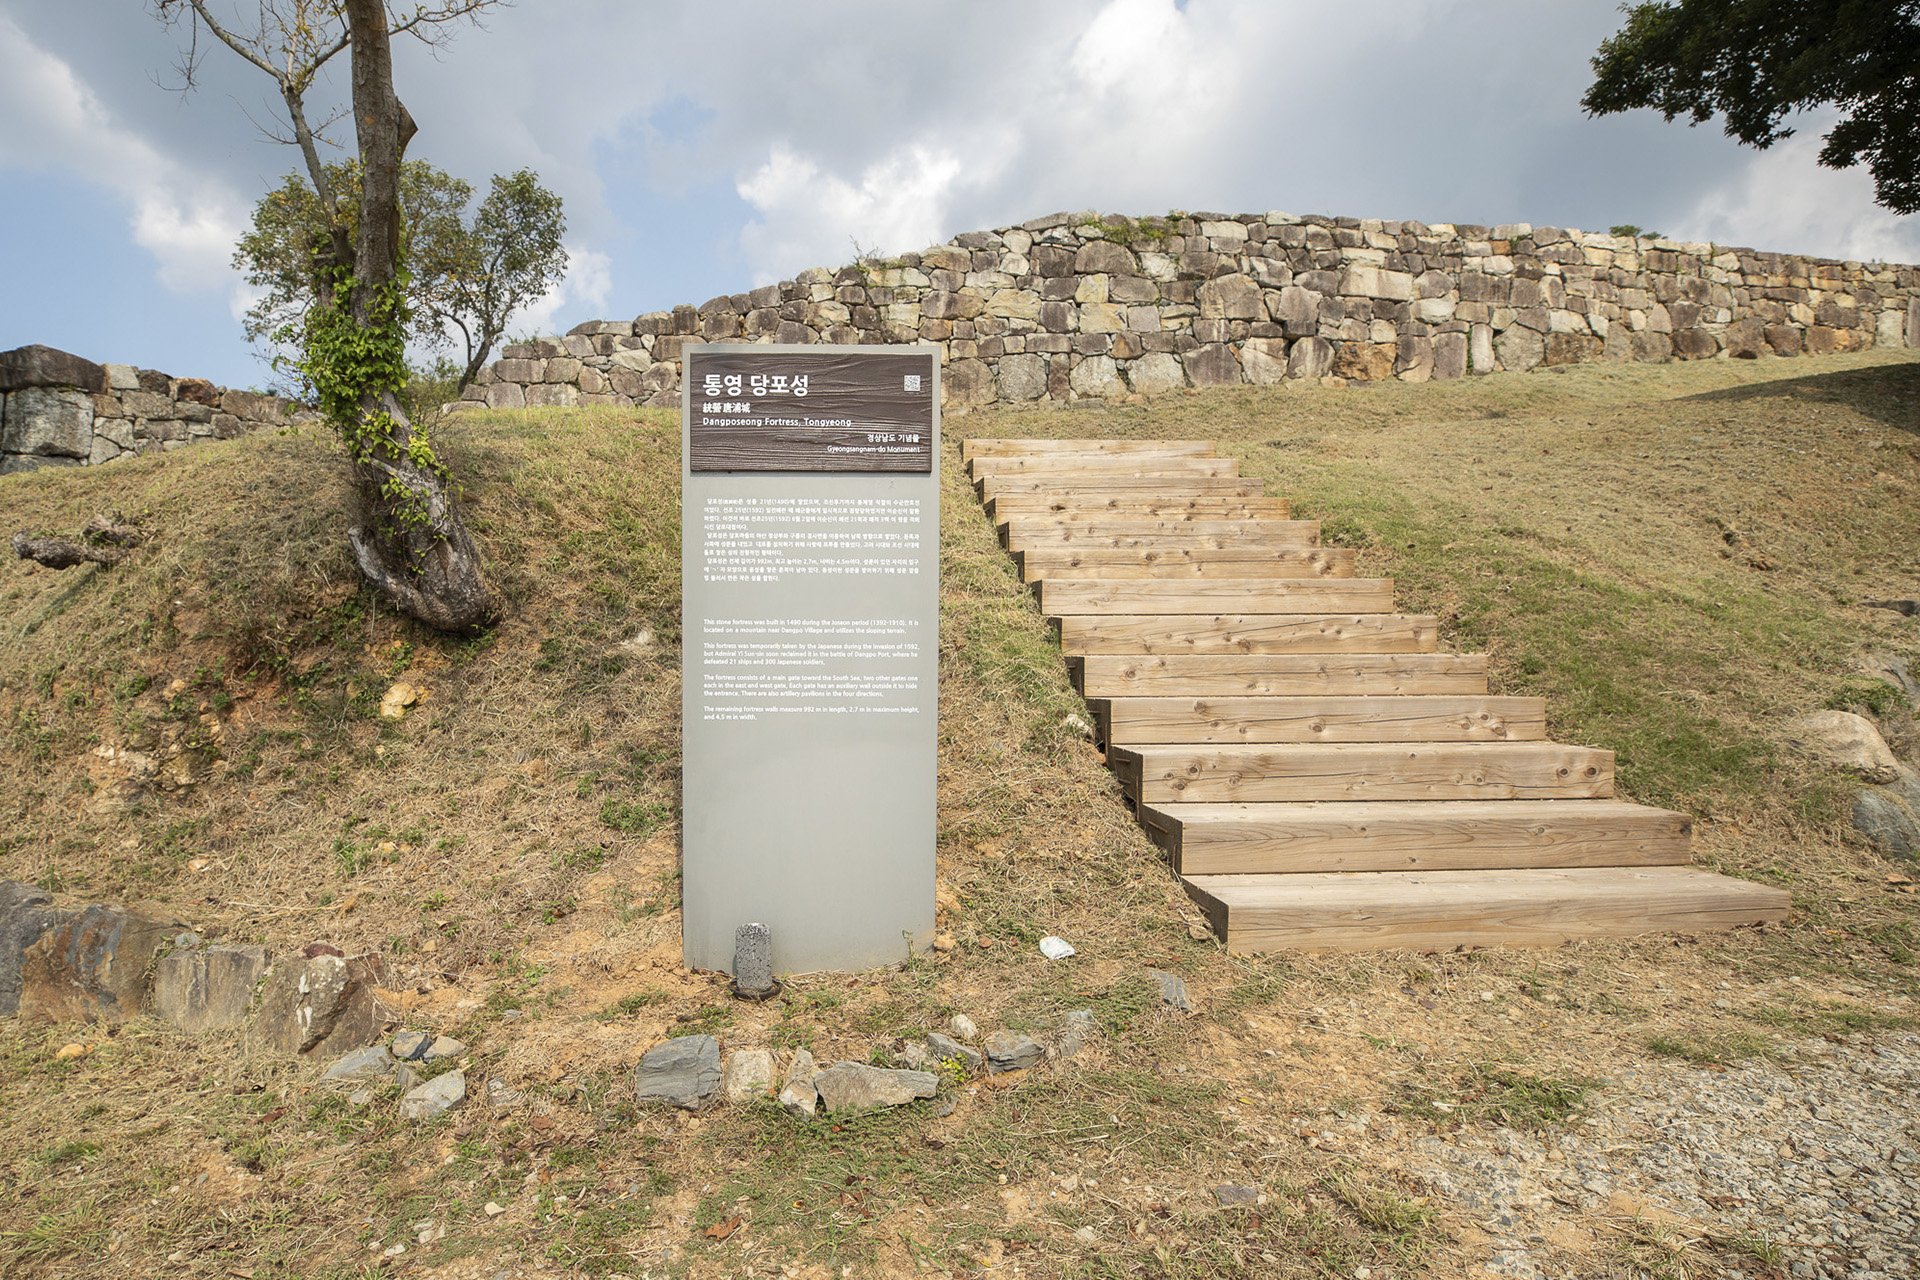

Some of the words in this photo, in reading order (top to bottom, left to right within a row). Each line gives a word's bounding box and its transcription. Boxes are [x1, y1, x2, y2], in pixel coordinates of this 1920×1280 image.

[702, 374, 742, 396] 통영
[750, 374, 808, 397] 당포성
[702, 418, 762, 427] Dangposeong
[765, 418, 800, 427] Fortress,
[804, 418, 852, 427] Tongyeong
[868, 434, 896, 442] 경상남도
[898, 434, 920, 442] 기념물
[827, 445, 886, 453] Gyeongsangnam-do
